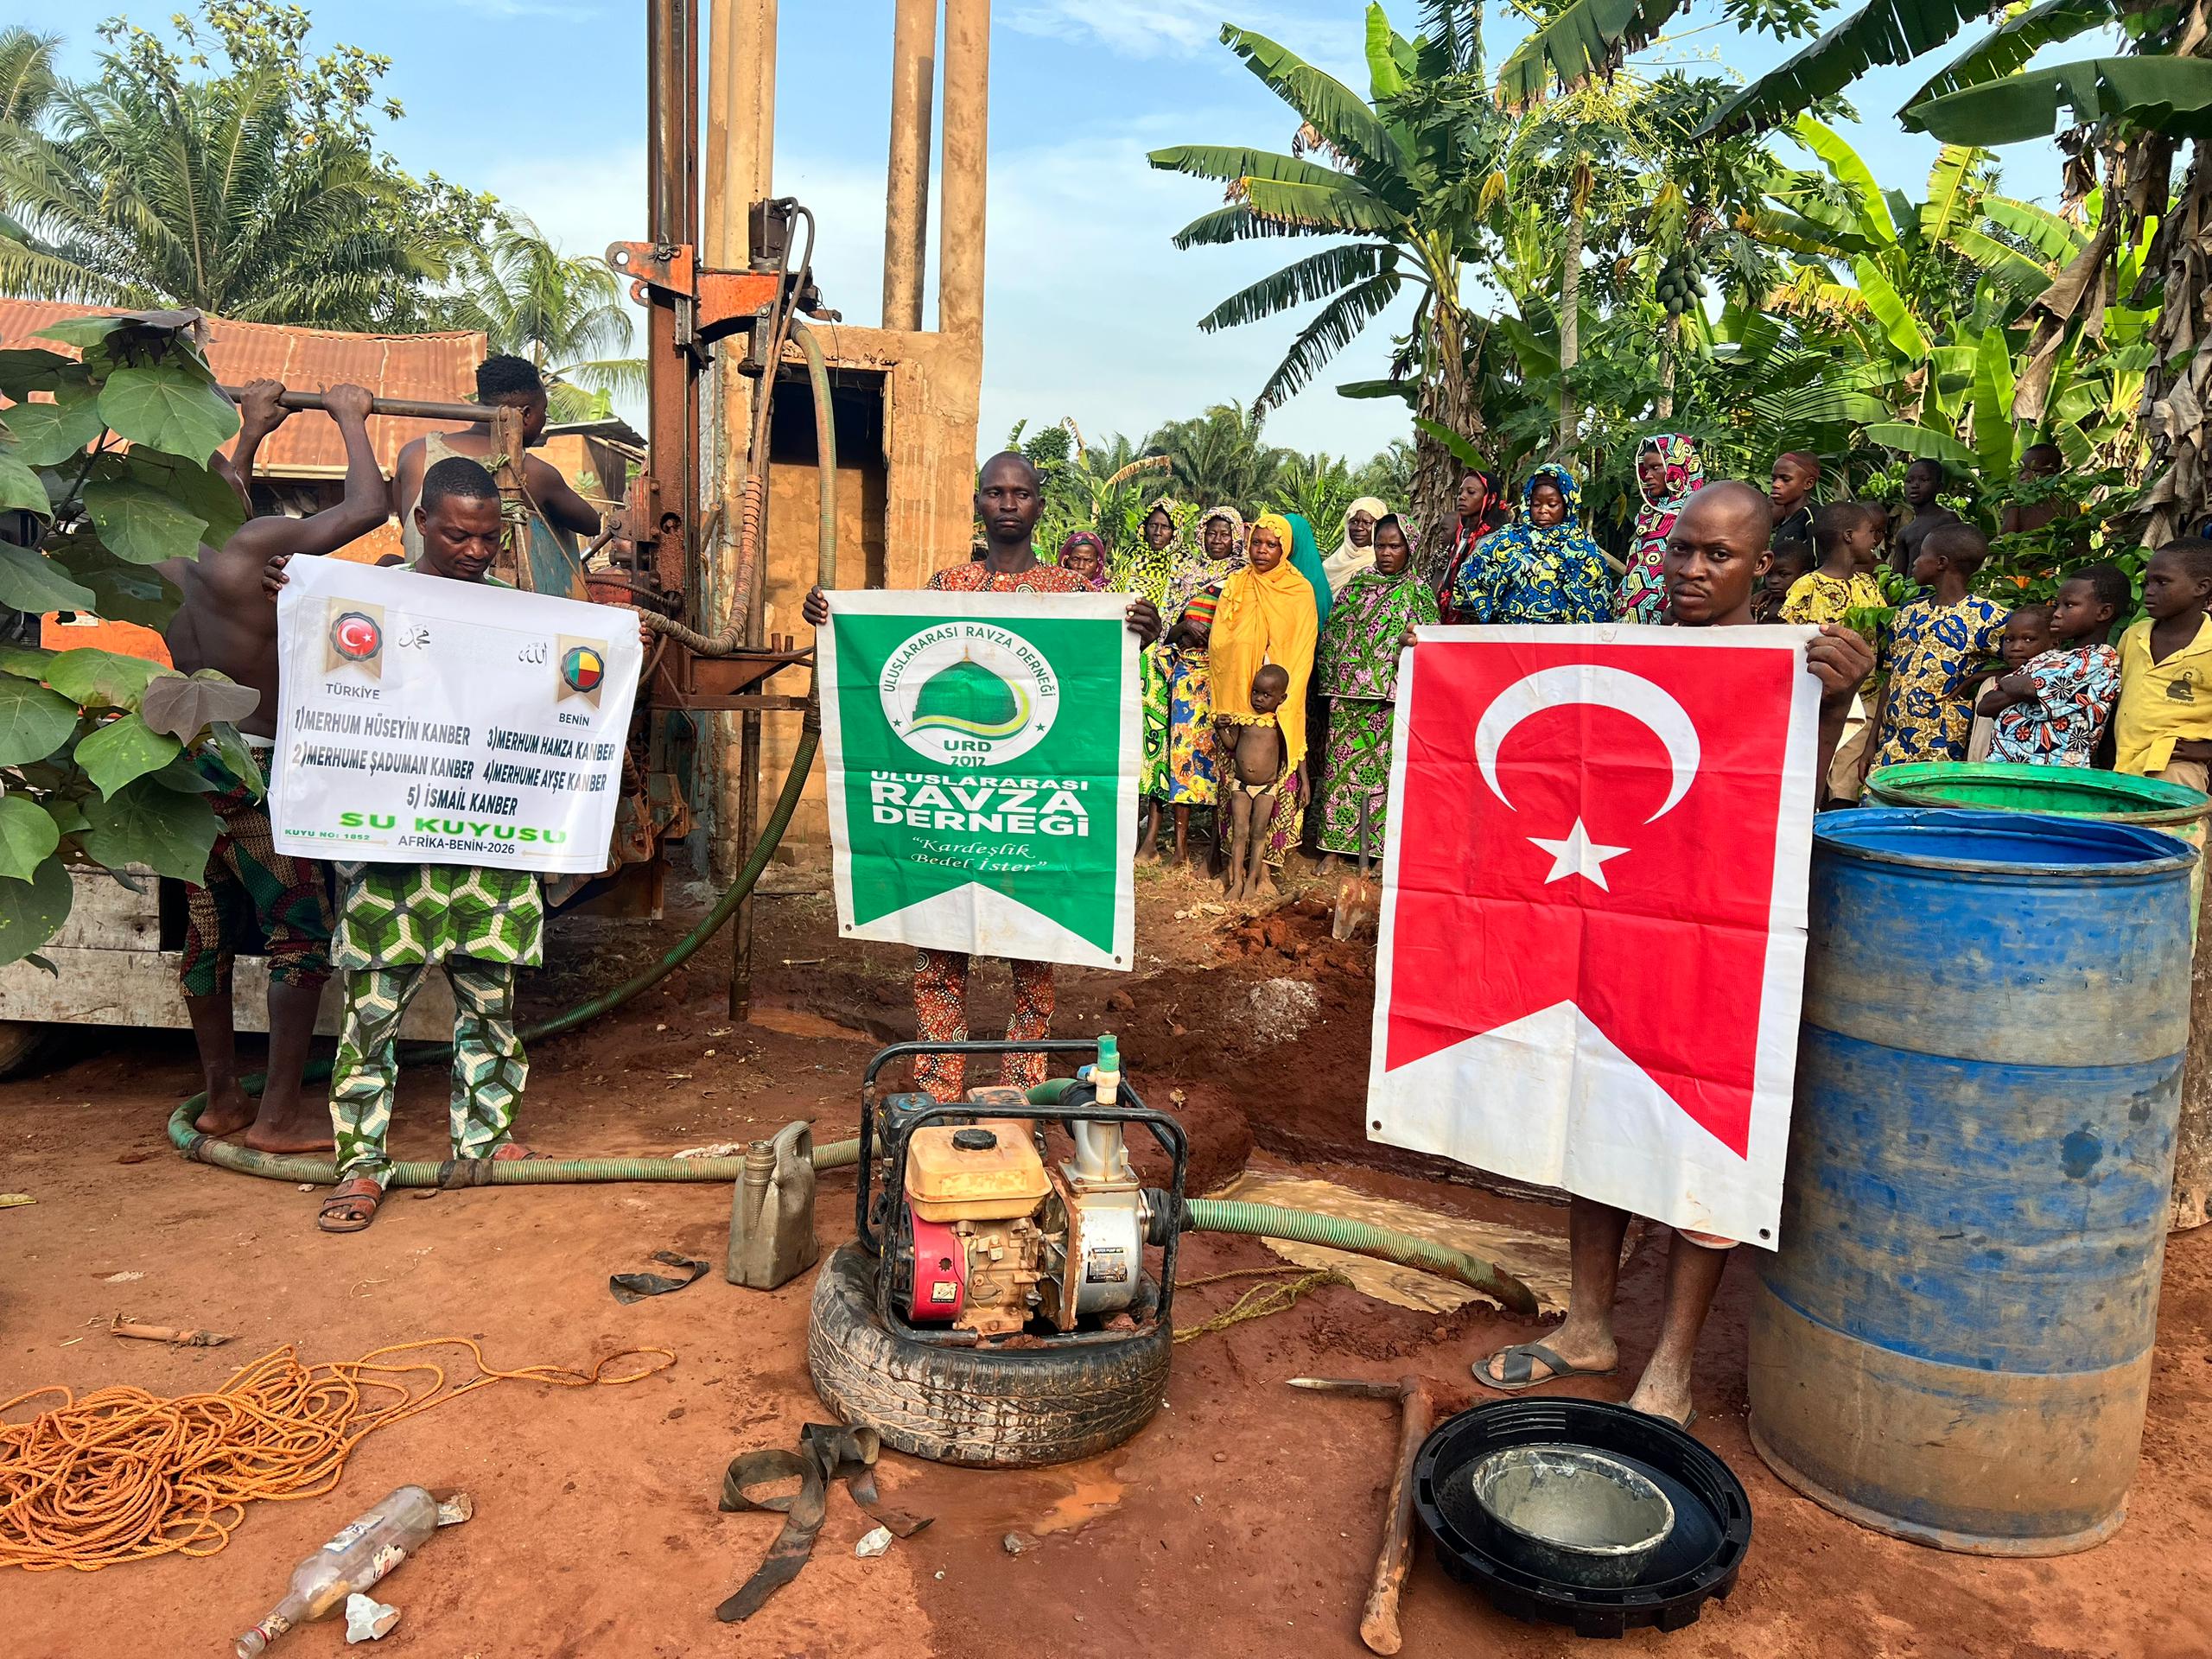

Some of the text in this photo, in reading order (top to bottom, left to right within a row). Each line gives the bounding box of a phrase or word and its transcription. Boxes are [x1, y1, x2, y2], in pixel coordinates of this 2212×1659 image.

[883, 626, 1057, 698] ULUSLARARASI RAVZA DERNEĞİ
[326, 682, 380, 700] TÜRKİYE
[364, 713, 418, 741] HÜSEYİN
[422, 722, 471, 746] KANBER
[558, 713, 590, 727] BENİN
[539, 736, 573, 760] HAMZA
[575, 741, 616, 761] KANBER
[944, 740, 992, 753] URD
[370, 750, 429, 777] ŞADUMAN
[429, 756, 475, 779] KANBER
[950, 755, 986, 767] 2012
[540, 769, 566, 794] AYŞE
[567, 772, 607, 792] KANBER
[871, 770, 1089, 791] ULUSLARARASI
[406, 783, 518, 817] 5) İSMAİL KANBER
[870, 780, 1089, 816] RAVZA
[339, 811, 567, 844] SU KUYUSU
[872, 804, 1089, 837] DERNEĞİ
[284, 829, 371, 842] KUYU NO: 1852
[397, 835, 515, 855] AFRİKA-BENİN-2026
[911, 854, 974, 869] Bedel
